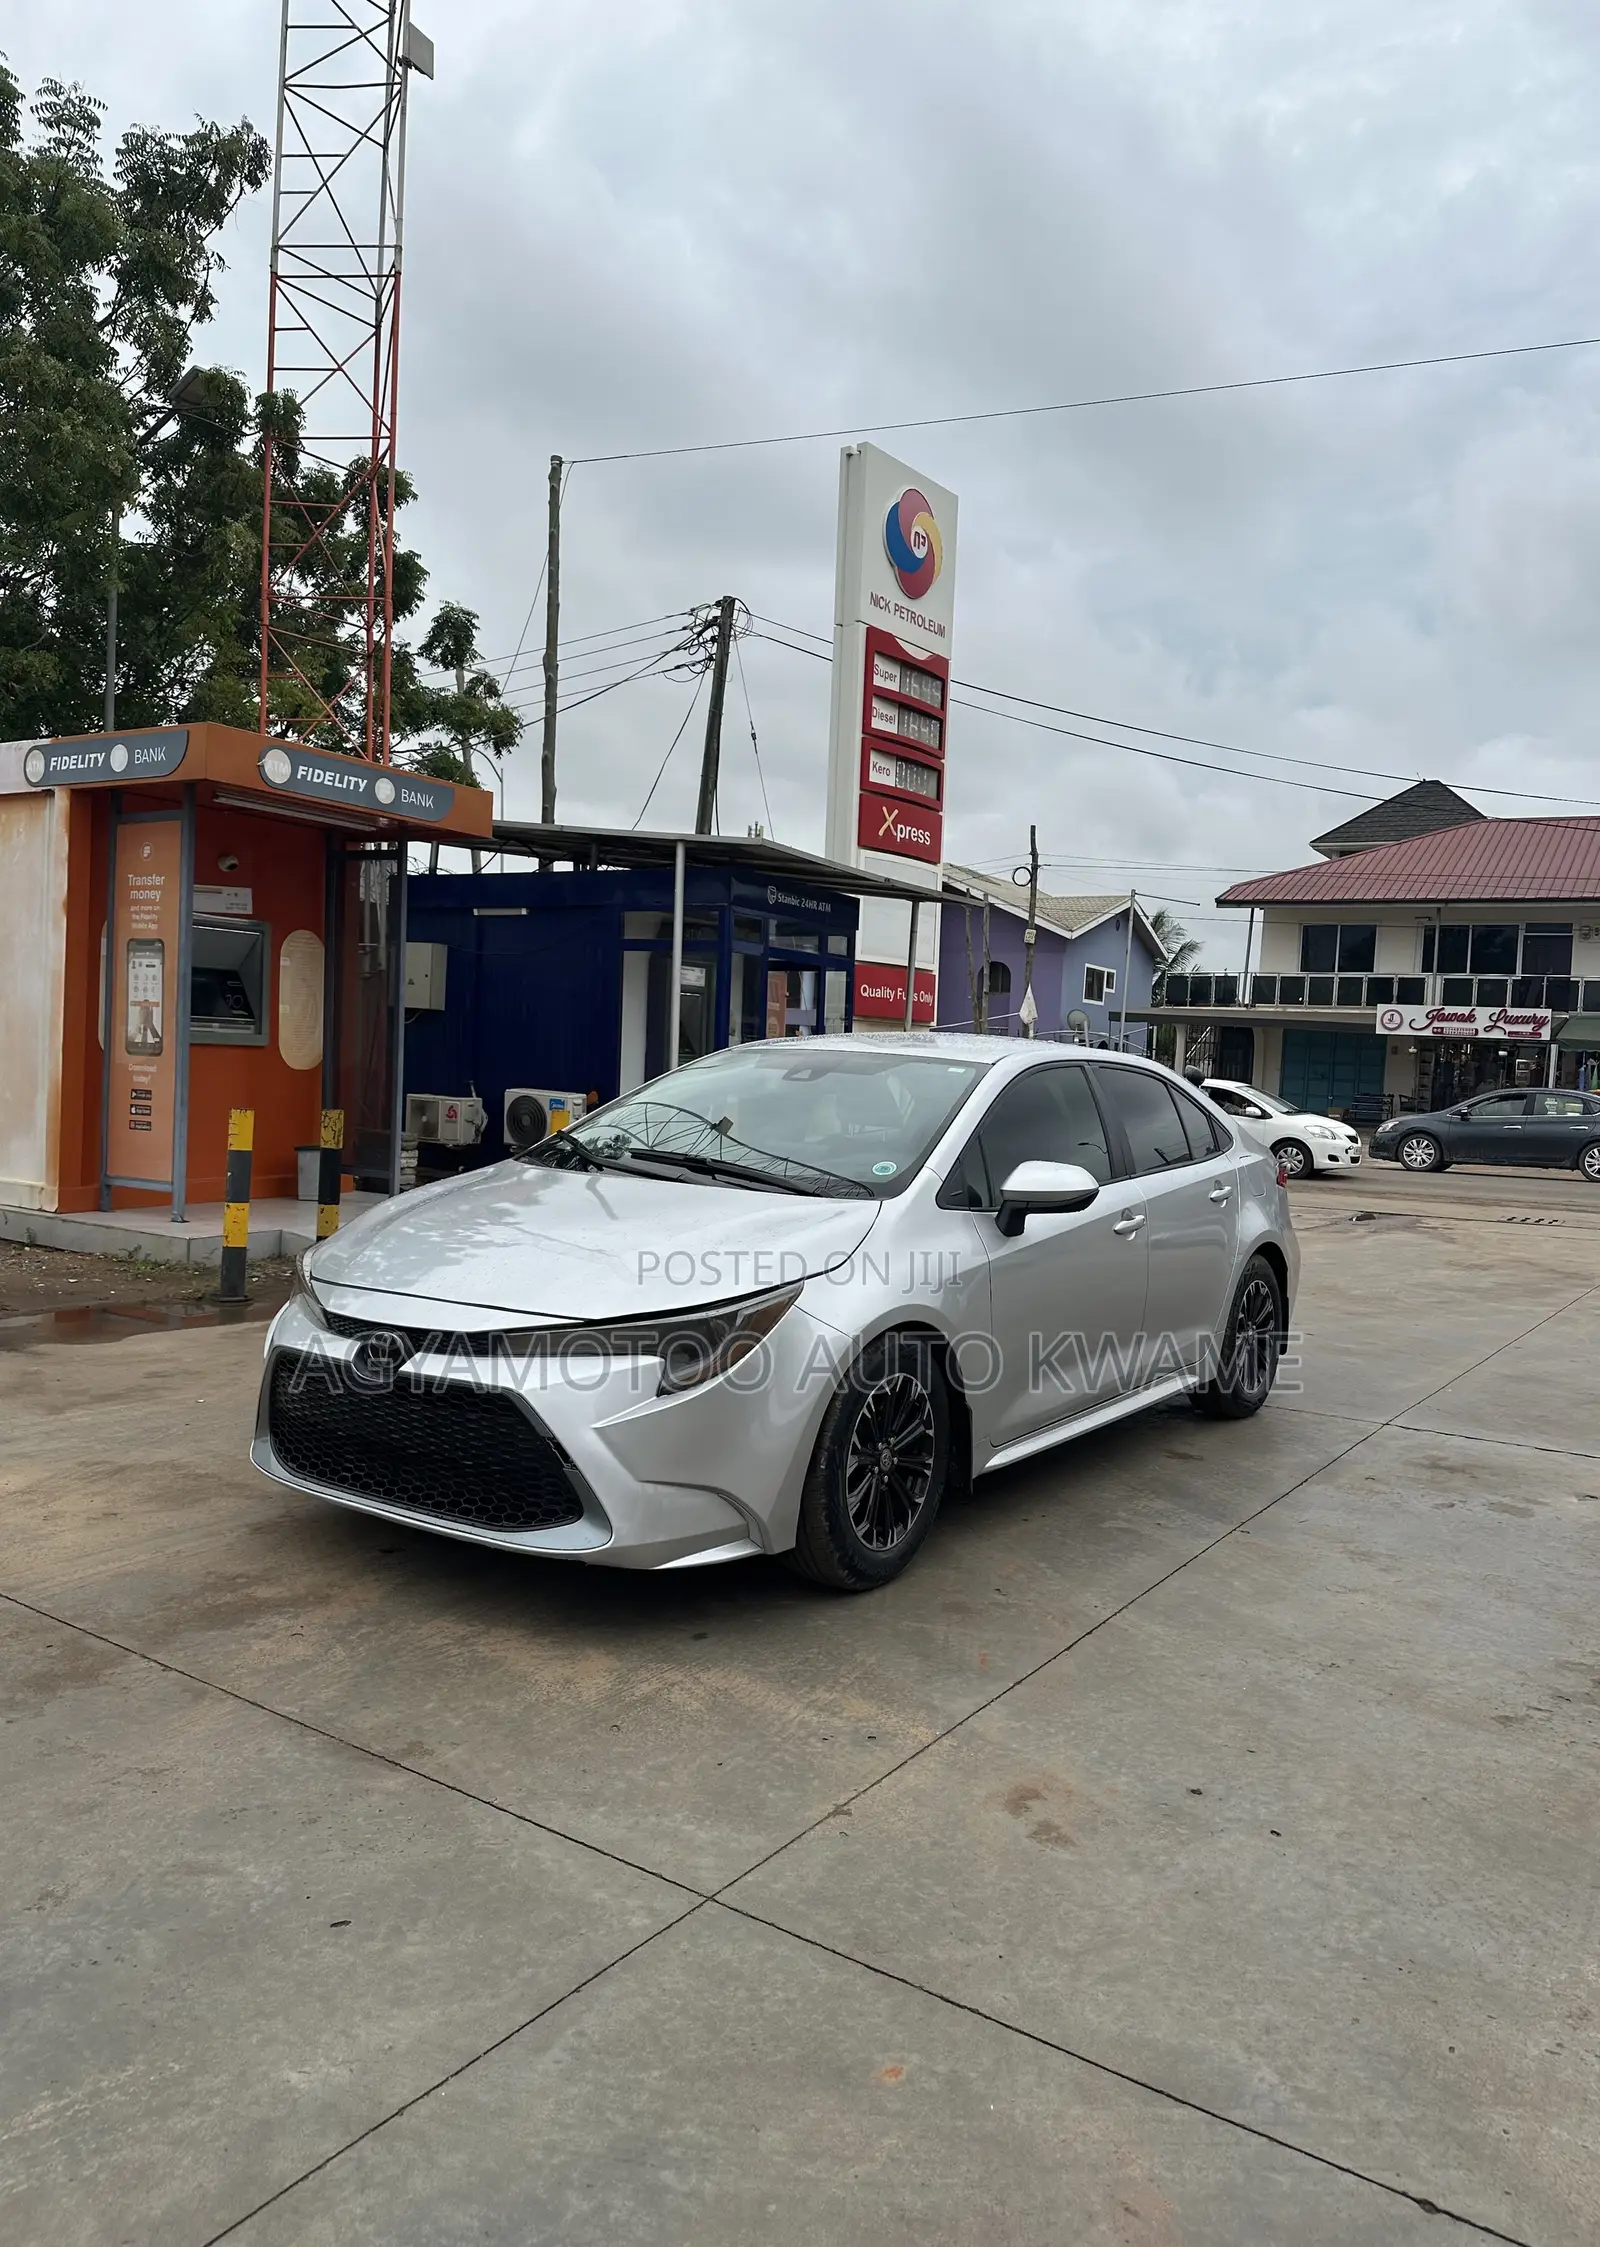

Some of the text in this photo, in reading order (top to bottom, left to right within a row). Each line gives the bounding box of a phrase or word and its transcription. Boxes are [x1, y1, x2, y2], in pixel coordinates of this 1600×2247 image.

[869, 591, 946, 639] NICK PETROLEUM
[874, 664, 898, 683] Super
[872, 706, 896, 725] Diesel
[49, 752, 106, 772] FIDELITY
[134, 746, 166, 764] BANK
[872, 761, 891, 777] Kero
[297, 765, 368, 793] FIDELITY
[401, 788, 434, 809] BANK
[878, 806, 931, 846] Xpress
[127, 873, 165, 886] Transfer
[130, 889, 161, 902] money
[777, 893, 800, 907] Stanbic
[818, 902, 831, 913] ATM
[860, 984, 934, 1006] Quality Fus Only
[1484, 1009, 1550, 1036] Luxury
